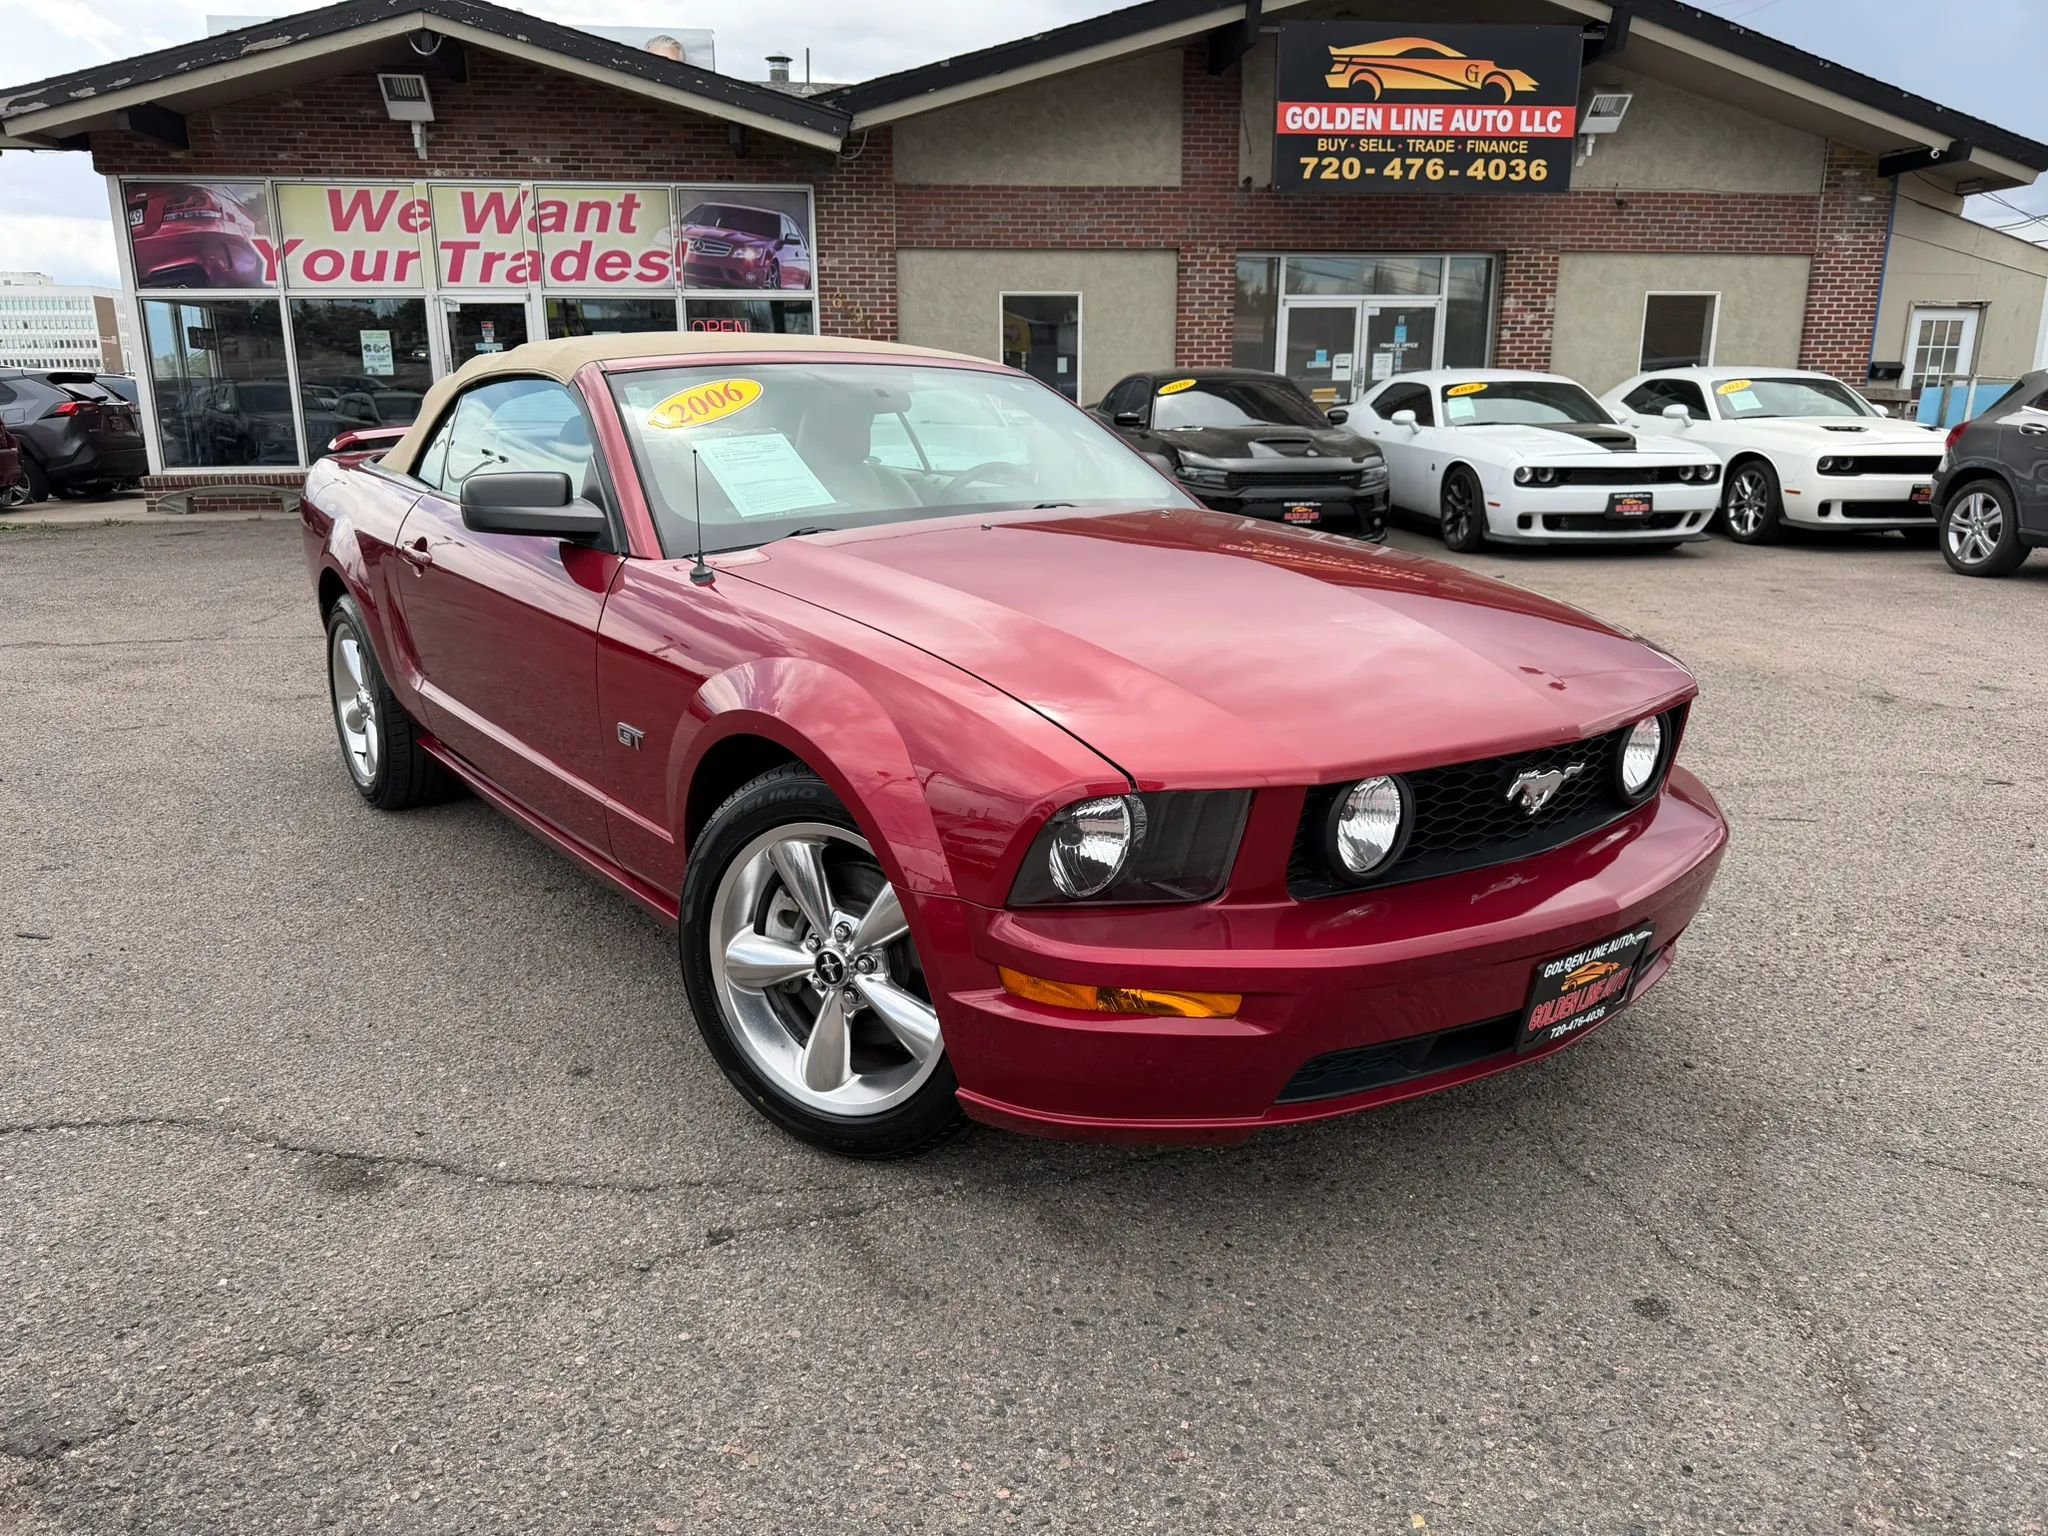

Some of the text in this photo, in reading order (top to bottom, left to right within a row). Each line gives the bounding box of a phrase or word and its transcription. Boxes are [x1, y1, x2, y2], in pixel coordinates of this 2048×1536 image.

[1464, 63, 1480, 83] G
[1284, 106, 1563, 134] GOLDEN LINE AUTO LLC
[1316, 138, 1529, 154] BUY SELL TRADE FINANCE
[326, 189, 642, 235] We Want
[250, 238, 689, 284] Your Trades!
[668, 381, 744, 424] 2006
[616, 721, 647, 752] GT
[1543, 951, 1586, 978] GOLDEN
[1584, 943, 1609, 962] LINE
[1606, 933, 1634, 953] AUTO
[1528, 966, 1632, 1031] GOLDEN LINE AUTO
[1550, 1006, 1606, 1039] 720-476-4036
